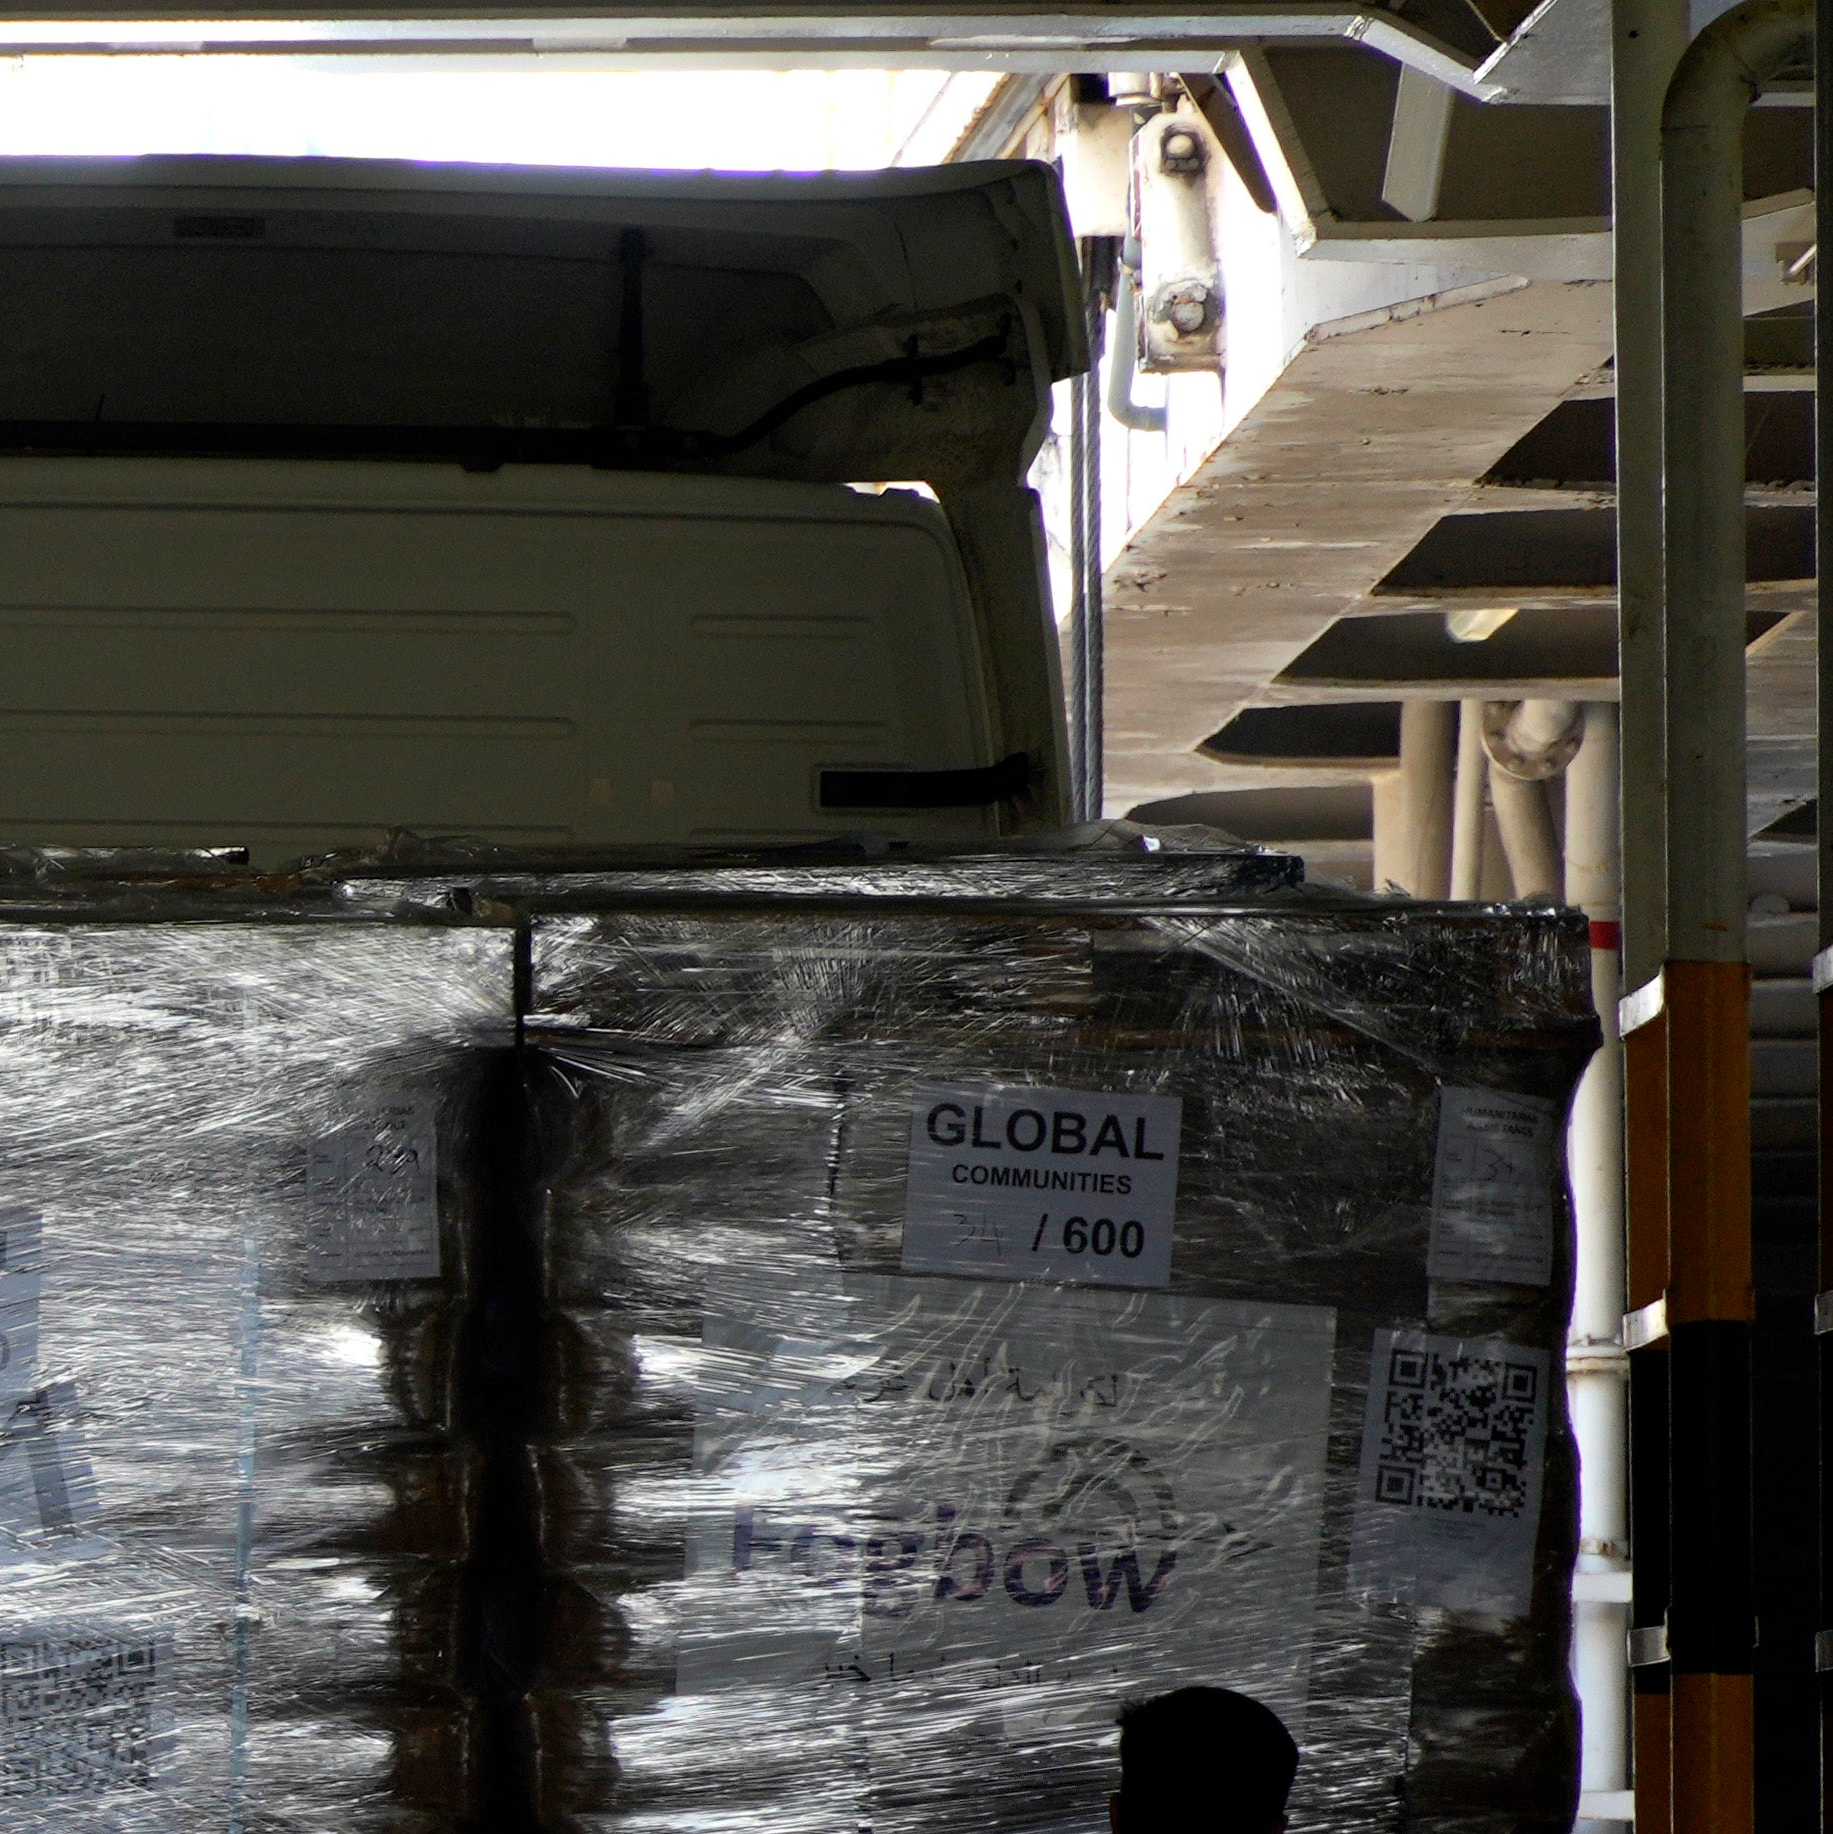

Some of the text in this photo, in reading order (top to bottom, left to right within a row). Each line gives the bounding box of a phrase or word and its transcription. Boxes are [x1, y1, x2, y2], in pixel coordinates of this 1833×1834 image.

[927, 1102, 1164, 1161] GLOBAL
[952, 1164, 1132, 1195] COMMUNITIES
[1032, 1213, 1049, 1252] /
[1063, 1216, 1145, 1258] 600
